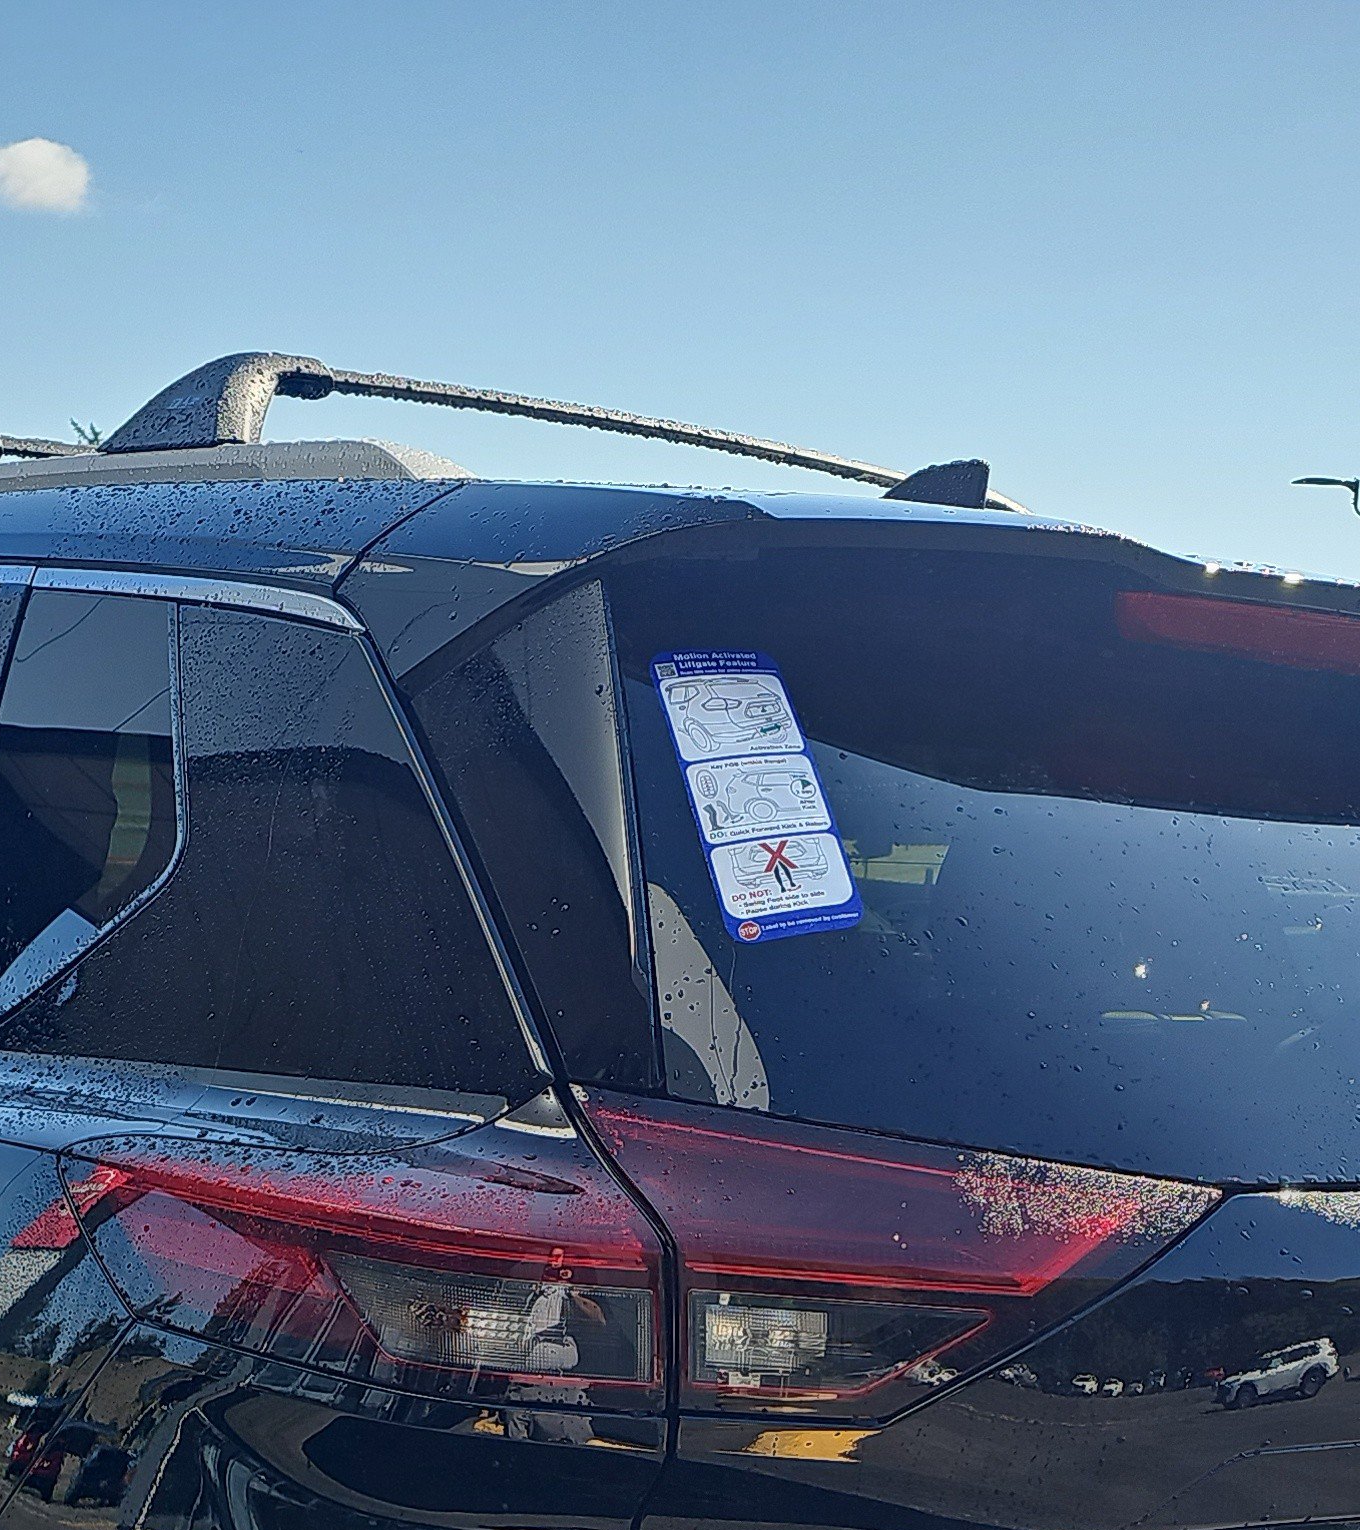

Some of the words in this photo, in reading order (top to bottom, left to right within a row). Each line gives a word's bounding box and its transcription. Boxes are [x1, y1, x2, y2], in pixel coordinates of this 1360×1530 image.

[673, 653, 709, 661] Motion
[711, 652, 757, 660] Activated
[679, 660, 717, 669] Liftgate
[732, 893, 746, 902] DO
[749, 889, 772, 899] NOT:
[740, 926, 758, 936] STOP
